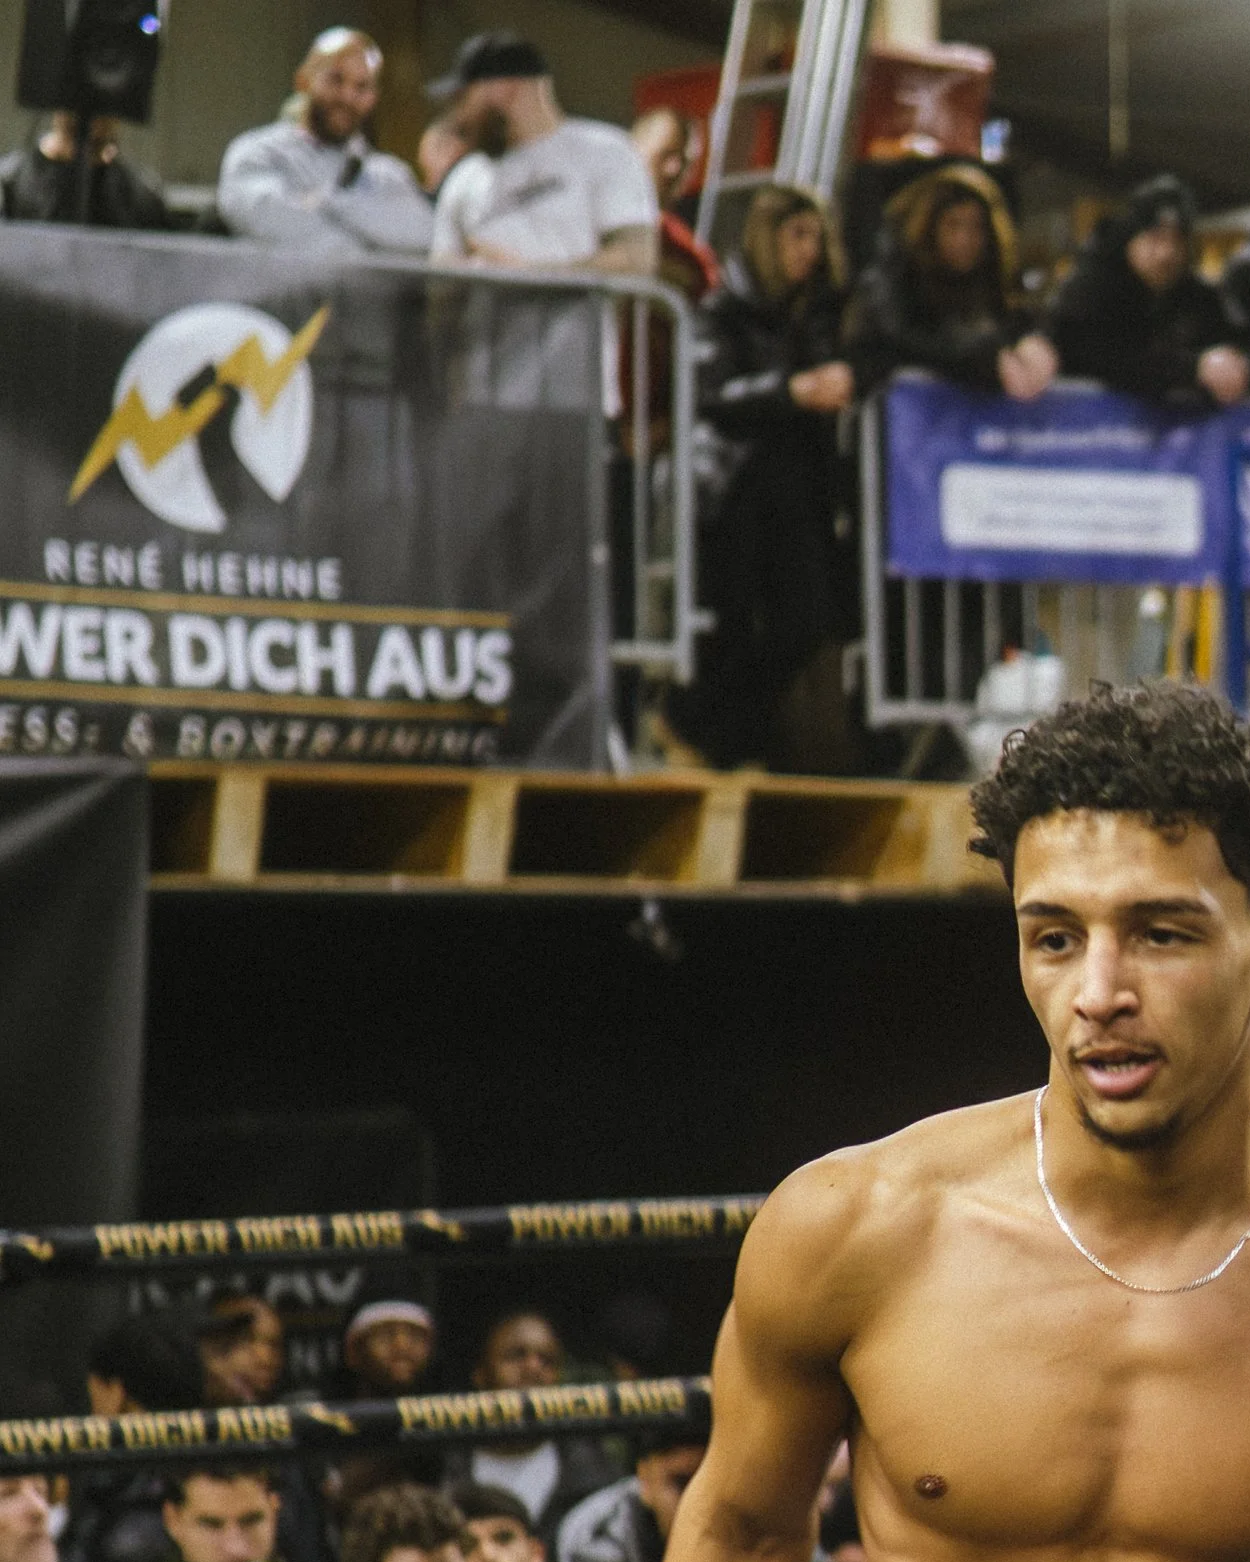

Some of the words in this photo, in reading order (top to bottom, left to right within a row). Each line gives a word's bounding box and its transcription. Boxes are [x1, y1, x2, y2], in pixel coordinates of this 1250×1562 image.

[43, 537, 163, 590] RENÉ
[181, 552, 343, 600] HEHNE
[168, 612, 357, 698] DICH
[366, 623, 514, 704] AUS
[95, 1222, 229, 1260] POWER
[236, 1216, 321, 1252] DICH
[331, 1210, 403, 1248] AUS
[509, 1200, 630, 1240] POWER
[0, 1416, 111, 1452] OWER
[119, 1411, 206, 1450] DICH
[217, 1405, 293, 1442] AUS
[397, 1388, 524, 1431] POWER
[529, 1384, 611, 1422] DICH
[616, 1378, 686, 1417] AUS
